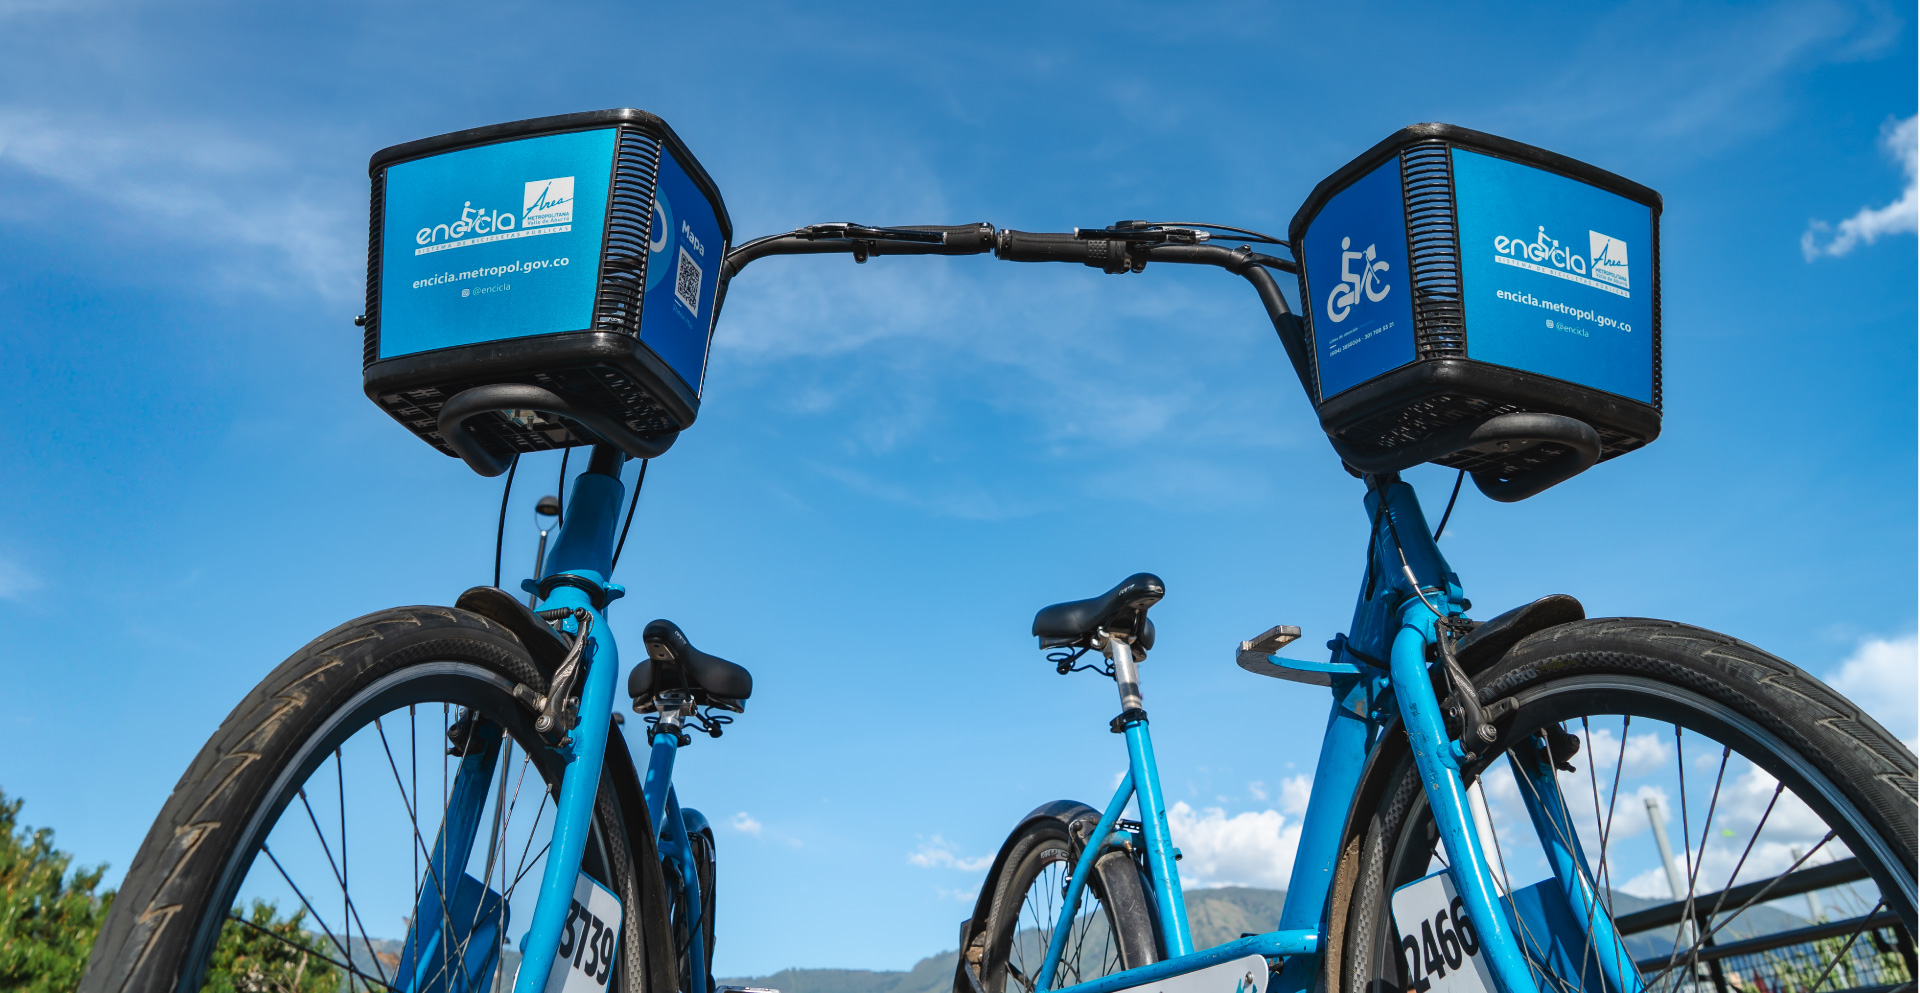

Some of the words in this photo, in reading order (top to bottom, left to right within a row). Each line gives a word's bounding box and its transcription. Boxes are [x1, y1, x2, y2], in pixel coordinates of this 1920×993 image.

[527, 211, 570, 221] METROPOLITANA
[417, 243, 452, 255] SISTEMA
[471, 233, 521, 245] BICICLETAS
[681, 219, 705, 257] Mapa
[412, 257, 570, 289] encicla.metropol.gov.co
[1497, 256, 1532, 270] SISTEMA
[1549, 269, 1592, 286] BICICLETAS
[472, 283, 511, 297] @encicla
[1497, 288, 1632, 333] encicla.metropol.gov.co
[1556, 322, 1589, 338] @encicla
[559, 898, 614, 986] 3739
[1402, 895, 1479, 993] 2466
